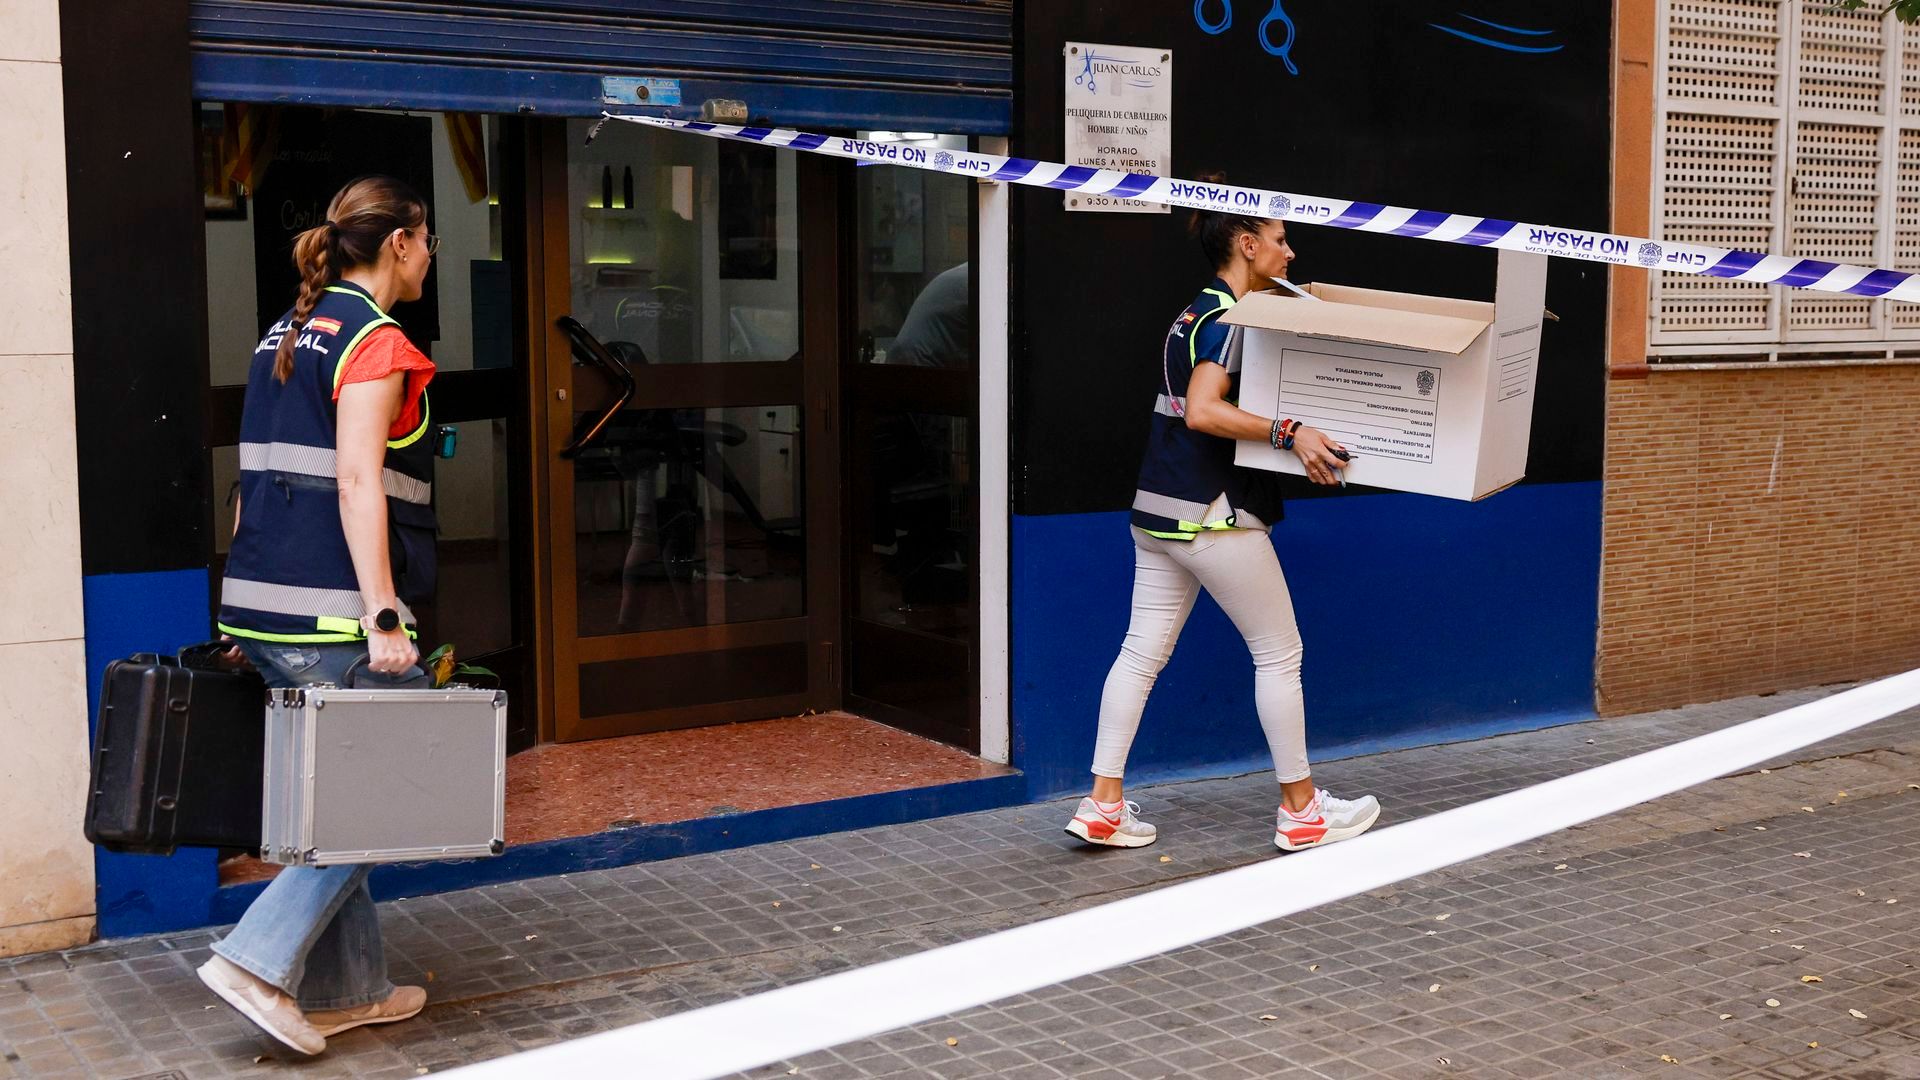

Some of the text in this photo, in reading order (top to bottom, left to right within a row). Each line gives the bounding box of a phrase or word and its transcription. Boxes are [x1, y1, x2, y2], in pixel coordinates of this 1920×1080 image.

[1093, 63, 1161, 77] JUAN CARLOS
[1067, 108, 1168, 121] PELUQUERIA DE CABALLEROS
[1087, 125, 1120, 135] HOMBRE
[1126, 125, 1148, 136] NIÑOS
[842, 139, 897, 159] PASAR
[902, 147, 926, 163] NO
[1097, 146, 1138, 156] HORARIO
[957, 159, 990, 172] CNP
[1078, 158, 1107, 166] LUNES
[1120, 159, 1157, 168] VIERNES
[1087, 197, 1109, 206] 9:30
[1113, 198, 1119, 206] A
[1170, 182, 1261, 208] NO PASAR
[1294, 204, 1331, 217] CNP
[1529, 228, 1629, 255] NO PASAR
[1666, 251, 1706, 266] CNP
[1351, 379, 1374, 387] GENERAL
